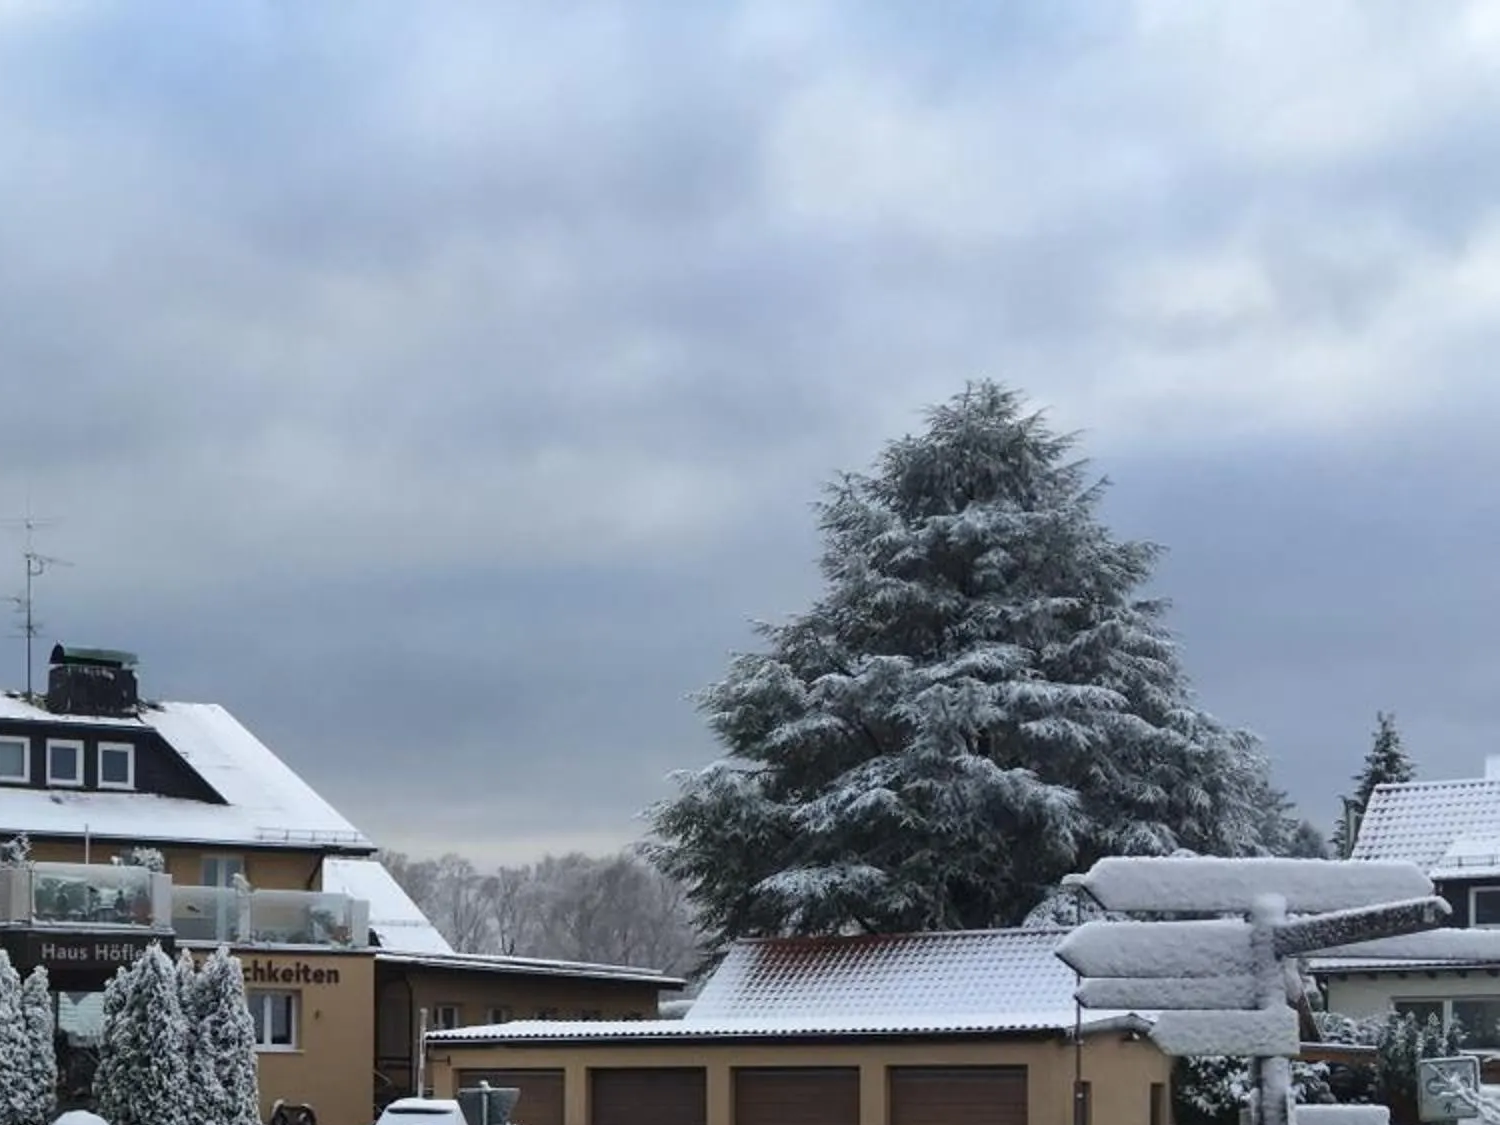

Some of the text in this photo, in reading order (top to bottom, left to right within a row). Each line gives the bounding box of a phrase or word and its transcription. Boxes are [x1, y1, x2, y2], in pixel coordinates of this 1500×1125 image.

[41, 943, 146, 960] Haus Höfle
[243, 959, 340, 984] chkeiten
